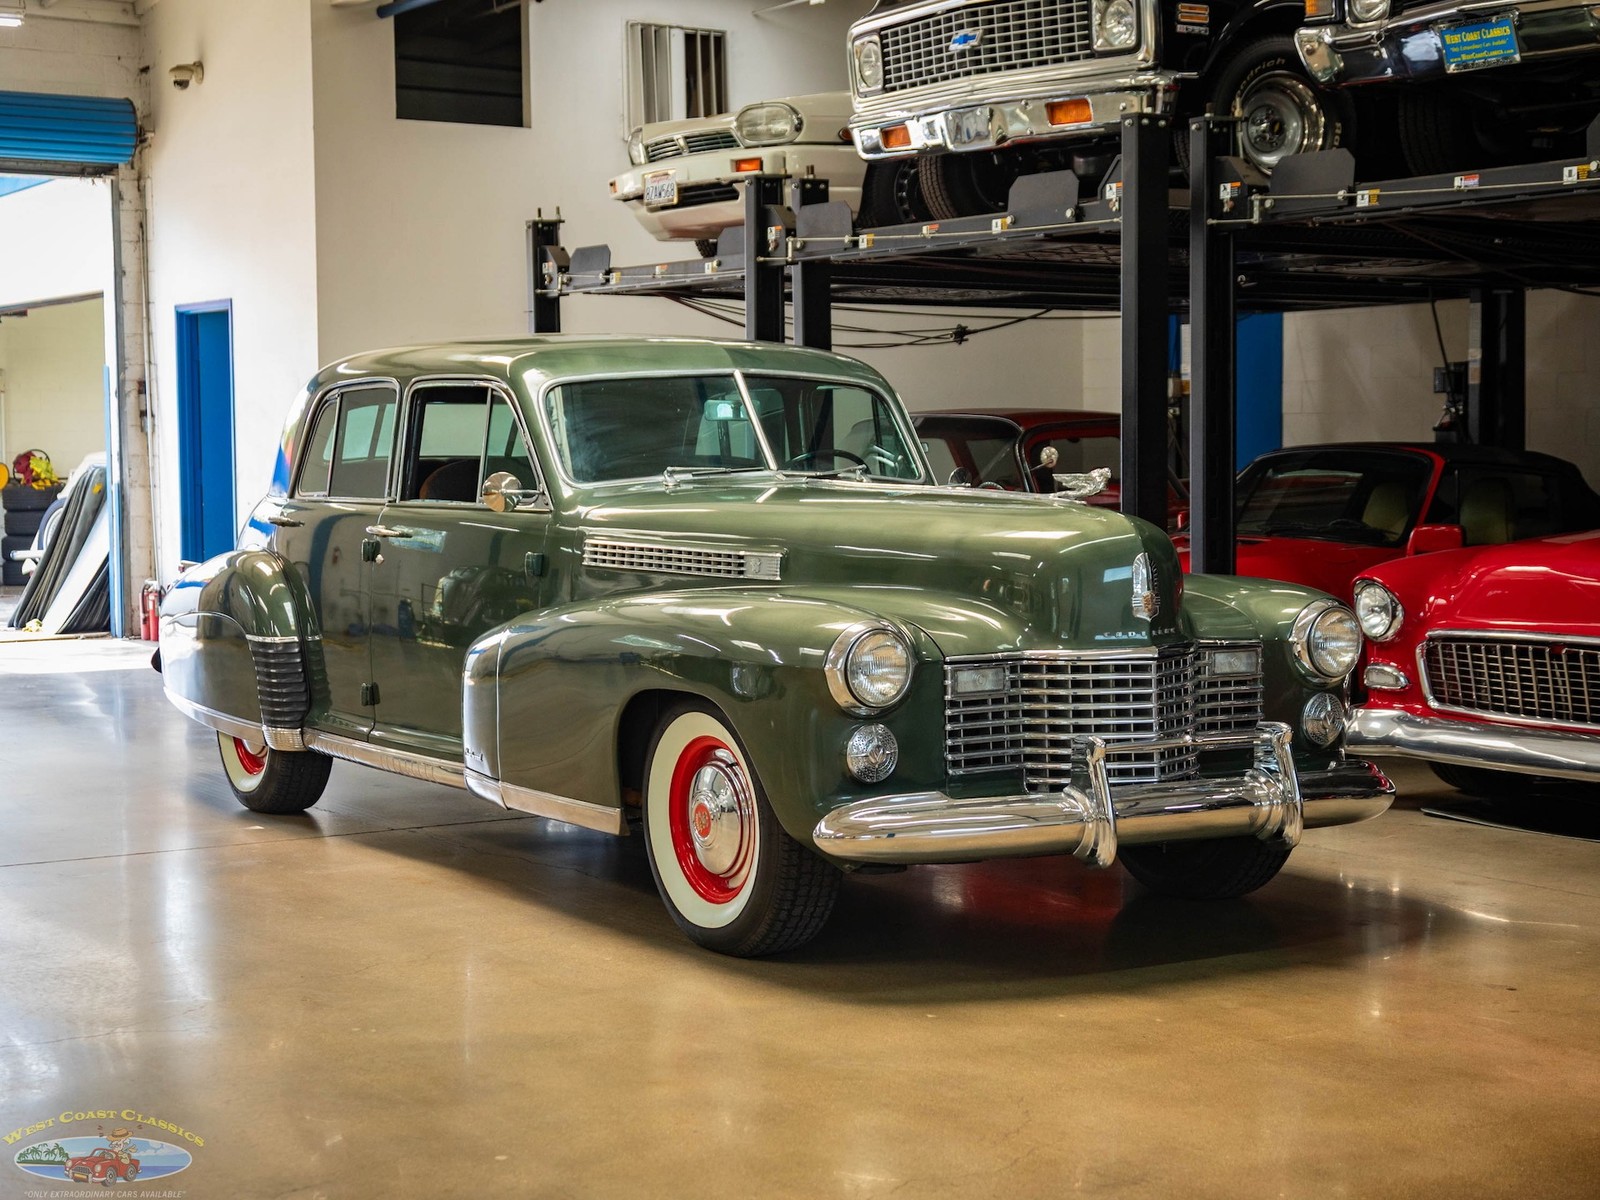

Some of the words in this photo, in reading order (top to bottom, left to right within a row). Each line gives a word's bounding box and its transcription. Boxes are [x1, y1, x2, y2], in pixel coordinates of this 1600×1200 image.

[1444, 34, 1462, 45] WEST
[1461, 30, 1481, 42] COAST
[1481, 26, 1511, 39] CLASSICS
